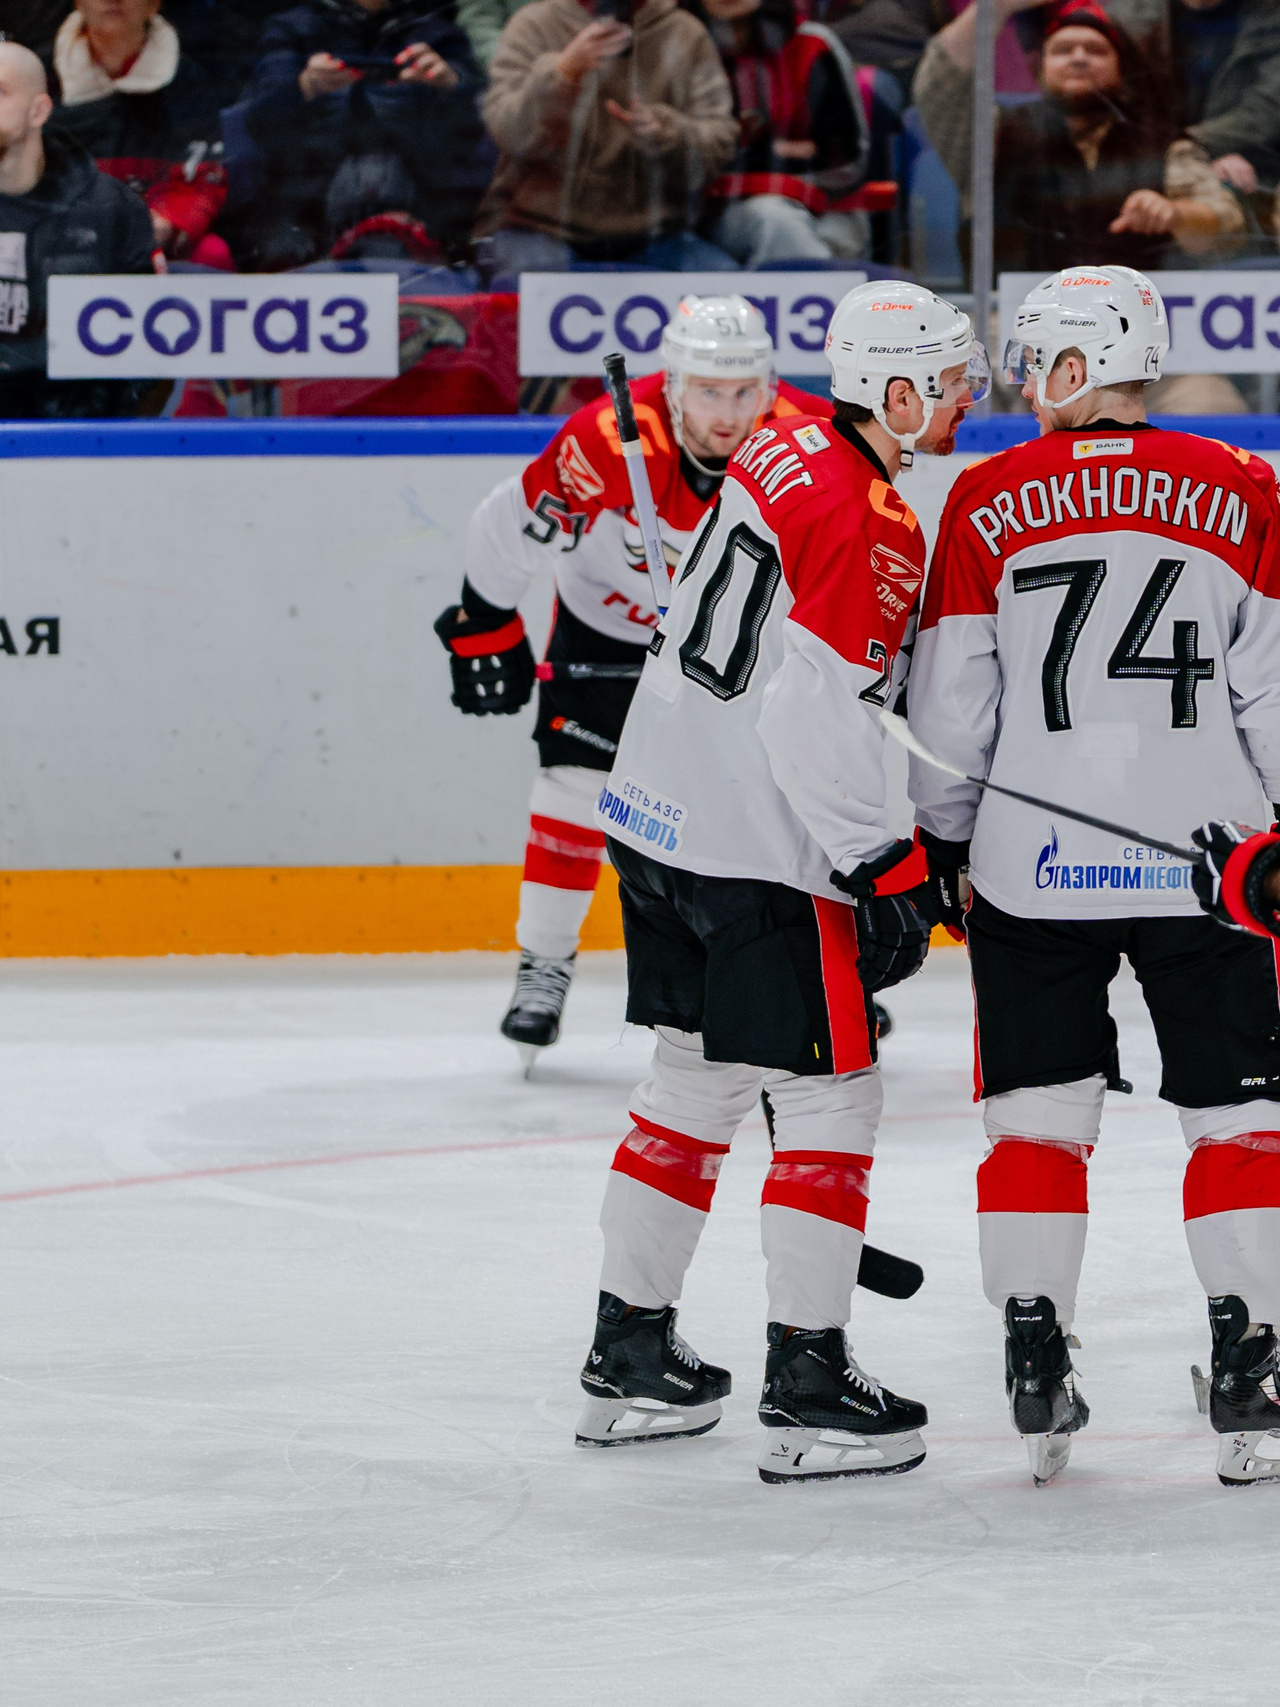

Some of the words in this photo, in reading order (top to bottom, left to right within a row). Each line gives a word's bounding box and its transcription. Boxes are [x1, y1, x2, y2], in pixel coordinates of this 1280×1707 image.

[550, 295, 834, 353] соз
[715, 316, 745, 337] 51
[867, 346, 914, 354] BAUER
[1144, 345, 1160, 373] 74
[969, 466, 1248, 557] PROKHORKIN
[0, 616, 60, 656] АЯ
[1012, 558, 1216, 734] 74
[623, 782, 650, 807] СЕТЬ
[653, 800, 683, 822] АЗС
[599, 787, 678, 852] ПРОМНЕФТЬ
[1053, 865, 1192, 890] ГАЗПРОМНЕФТ
[663, 1372, 695, 1392] BAUER
[839, 1395, 880, 1418] BAUER
